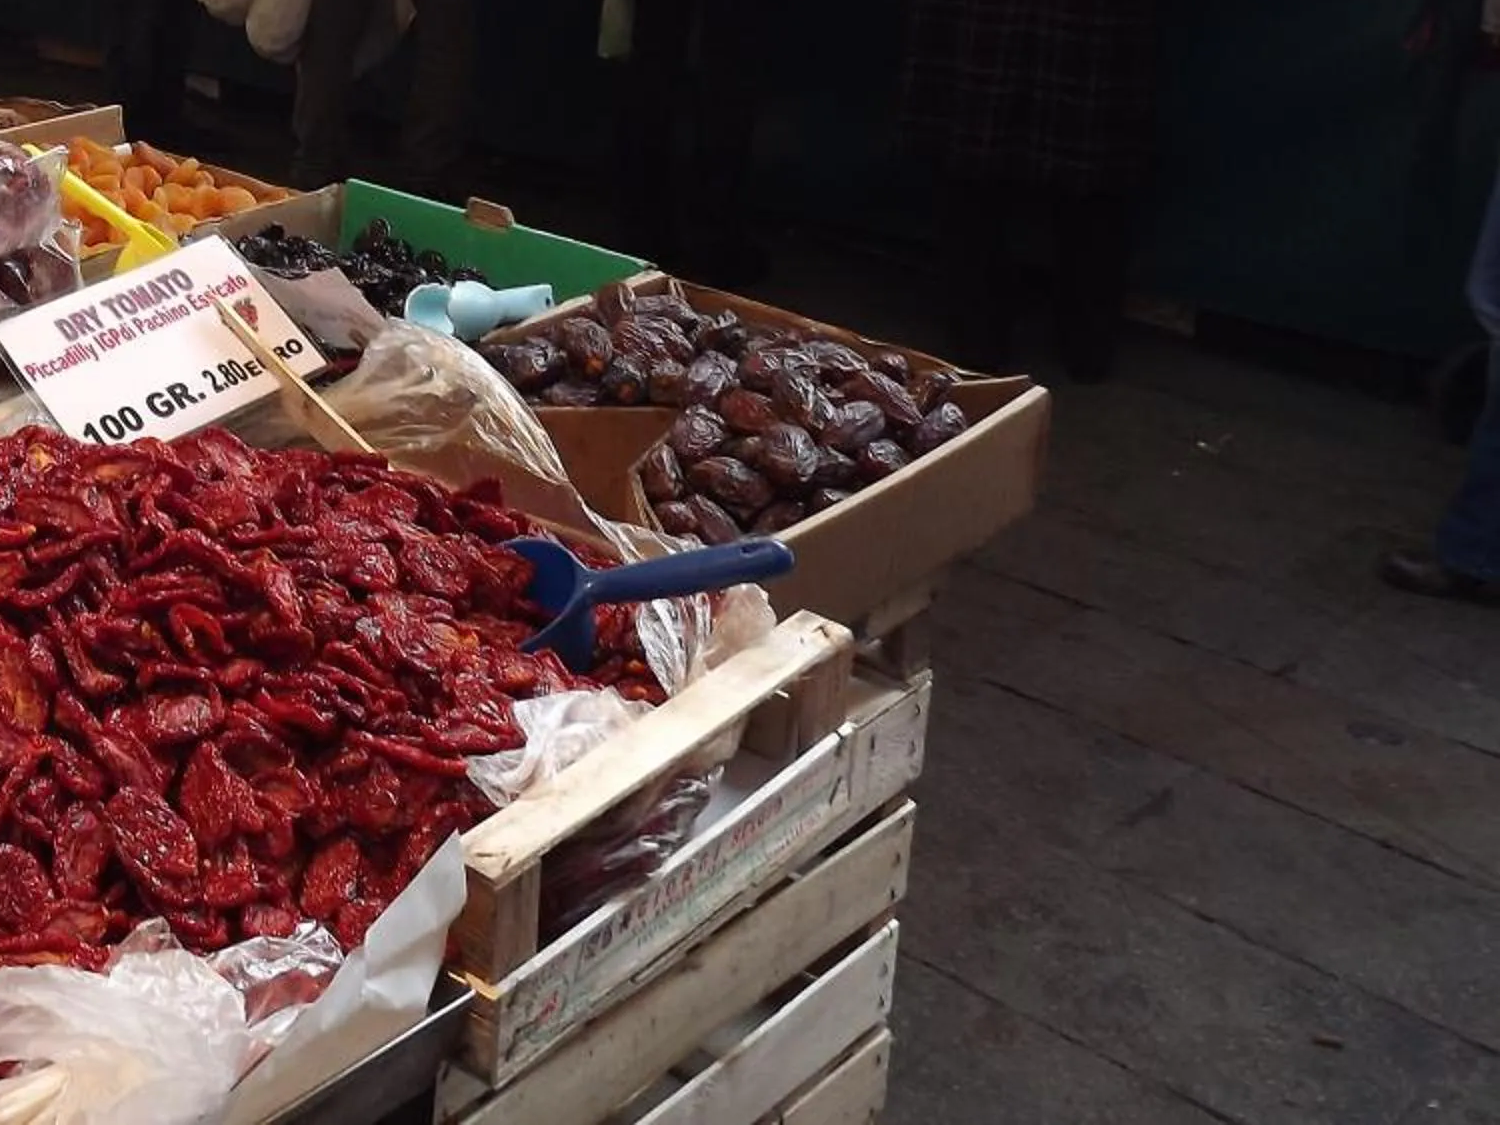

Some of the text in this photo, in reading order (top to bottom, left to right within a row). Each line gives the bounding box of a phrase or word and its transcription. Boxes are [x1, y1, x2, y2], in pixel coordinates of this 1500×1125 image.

[53, 268, 195, 342] DRY TOMATO
[23, 343, 100, 383] Piccadilly
[131, 302, 192, 335] Pachino
[83, 406, 145, 446] 100
[144, 381, 207, 419] GR.
